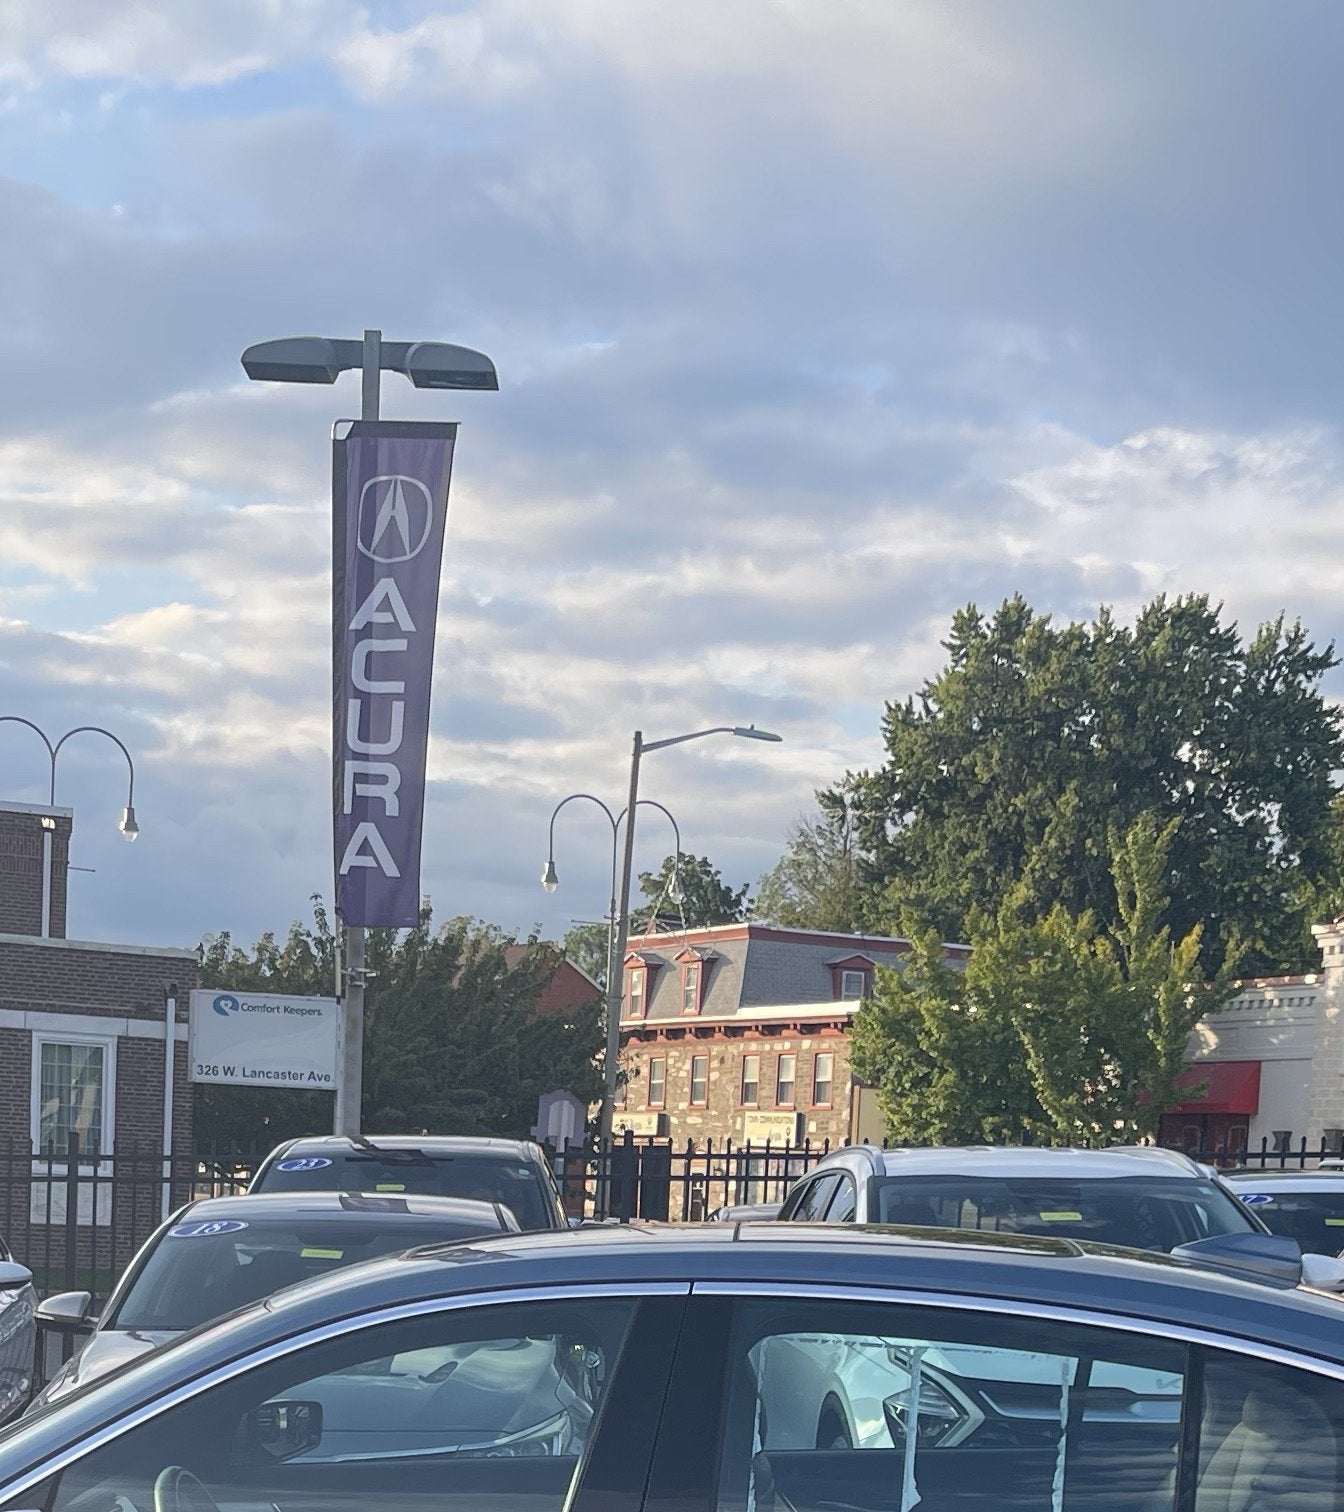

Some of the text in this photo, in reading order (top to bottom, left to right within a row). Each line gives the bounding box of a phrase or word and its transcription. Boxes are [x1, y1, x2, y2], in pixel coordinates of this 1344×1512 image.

[339, 577, 417, 878] ACURA
[240, 1002, 281, 1014] Comfort
[196, 1064, 220, 1077] 326
[242, 1067, 305, 1081] Lancaster
